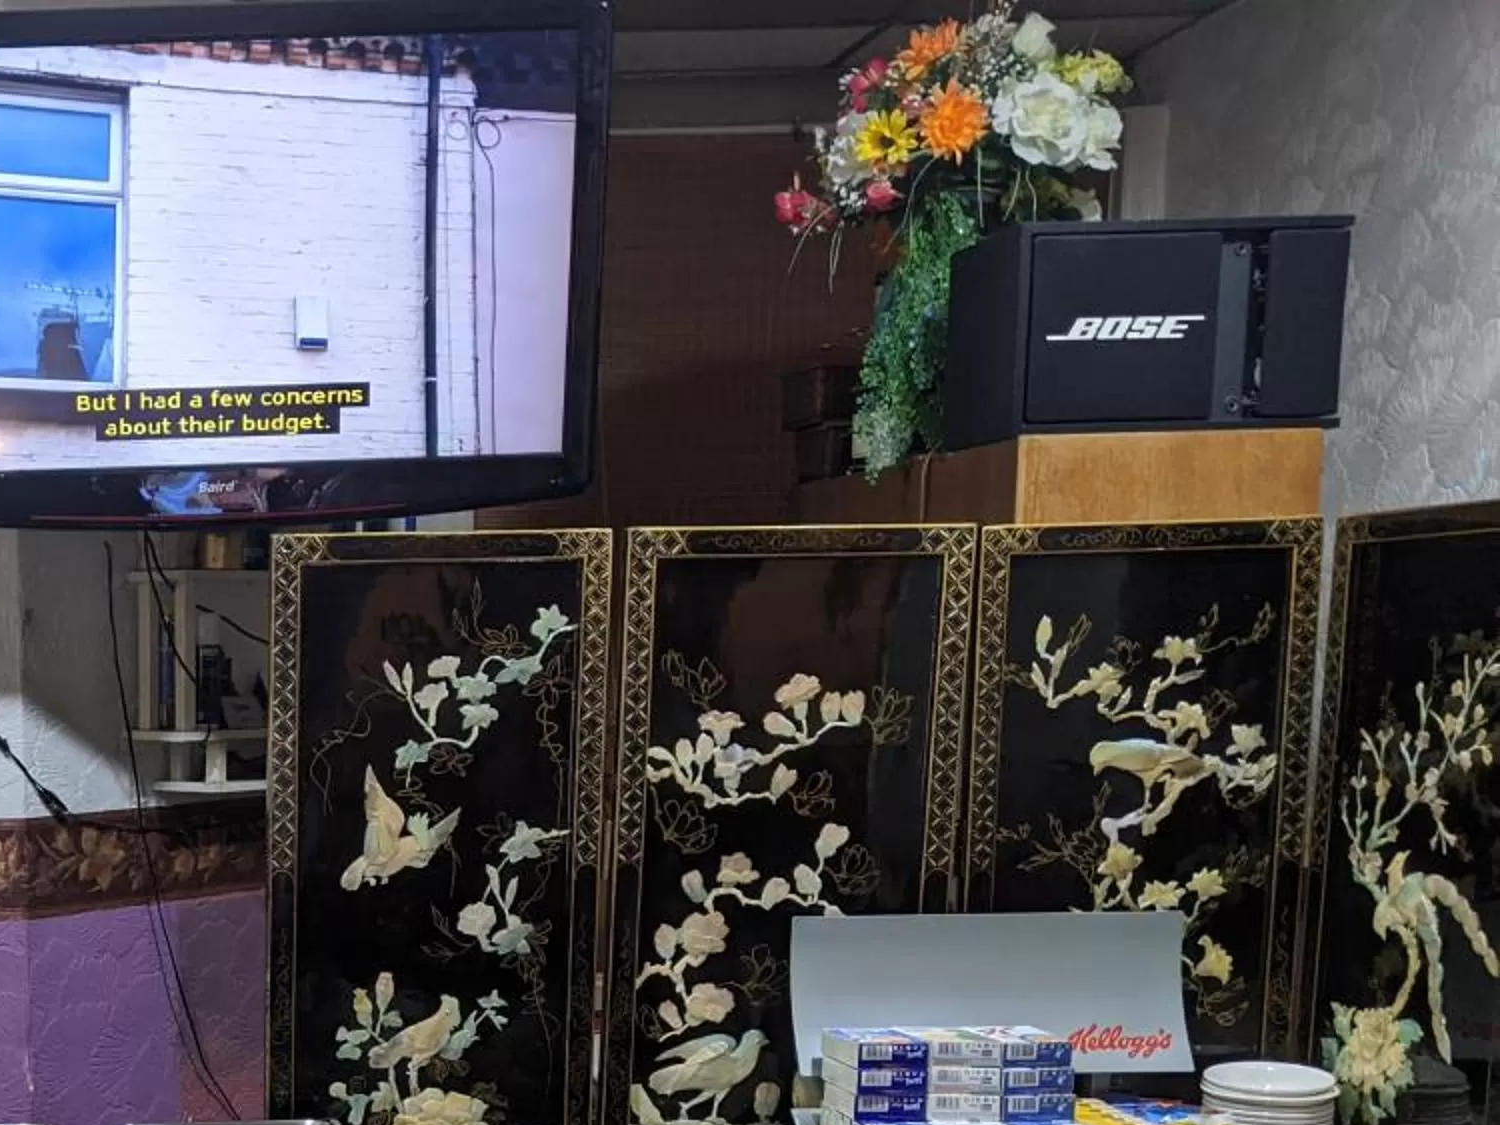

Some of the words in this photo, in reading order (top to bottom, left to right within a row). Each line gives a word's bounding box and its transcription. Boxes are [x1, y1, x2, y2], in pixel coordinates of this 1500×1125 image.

[1045, 314, 1205, 341] BOSE
[76, 394, 116, 412] But
[124, 393, 131, 410] I
[139, 391, 180, 410] had
[189, 394, 203, 408] a
[210, 389, 252, 407] few
[260, 387, 363, 407] concerns
[104, 417, 171, 437] about
[178, 414, 234, 434] their
[242, 412, 331, 437] budget.
[199, 480, 236, 494] Baird
[1067, 1023, 1174, 1060] Kellogg's
